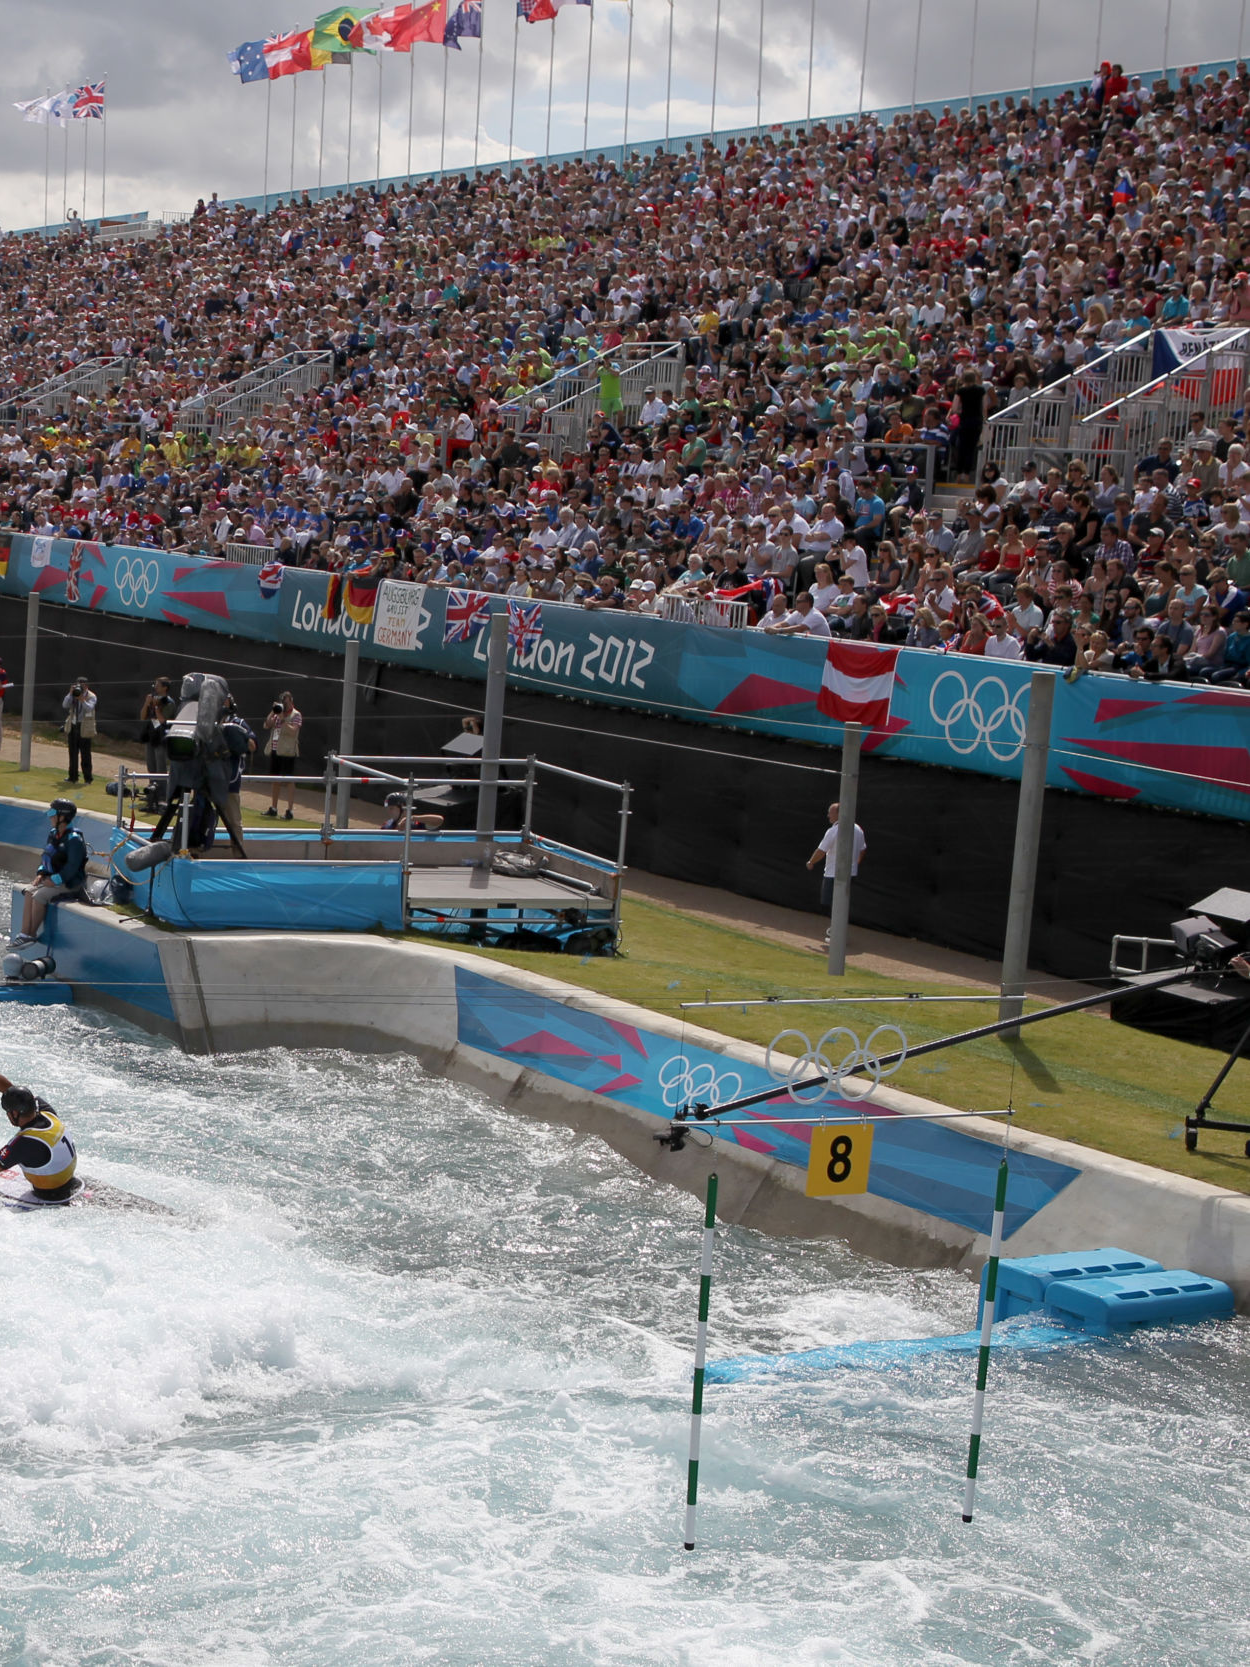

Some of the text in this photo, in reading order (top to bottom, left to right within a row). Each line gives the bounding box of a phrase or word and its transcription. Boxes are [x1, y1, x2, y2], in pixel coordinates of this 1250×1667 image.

[377, 626, 413, 648] GERMANY
[388, 616, 406, 628] TEAM
[580, 632, 656, 690] 2012
[826, 1135, 853, 1183] 8
